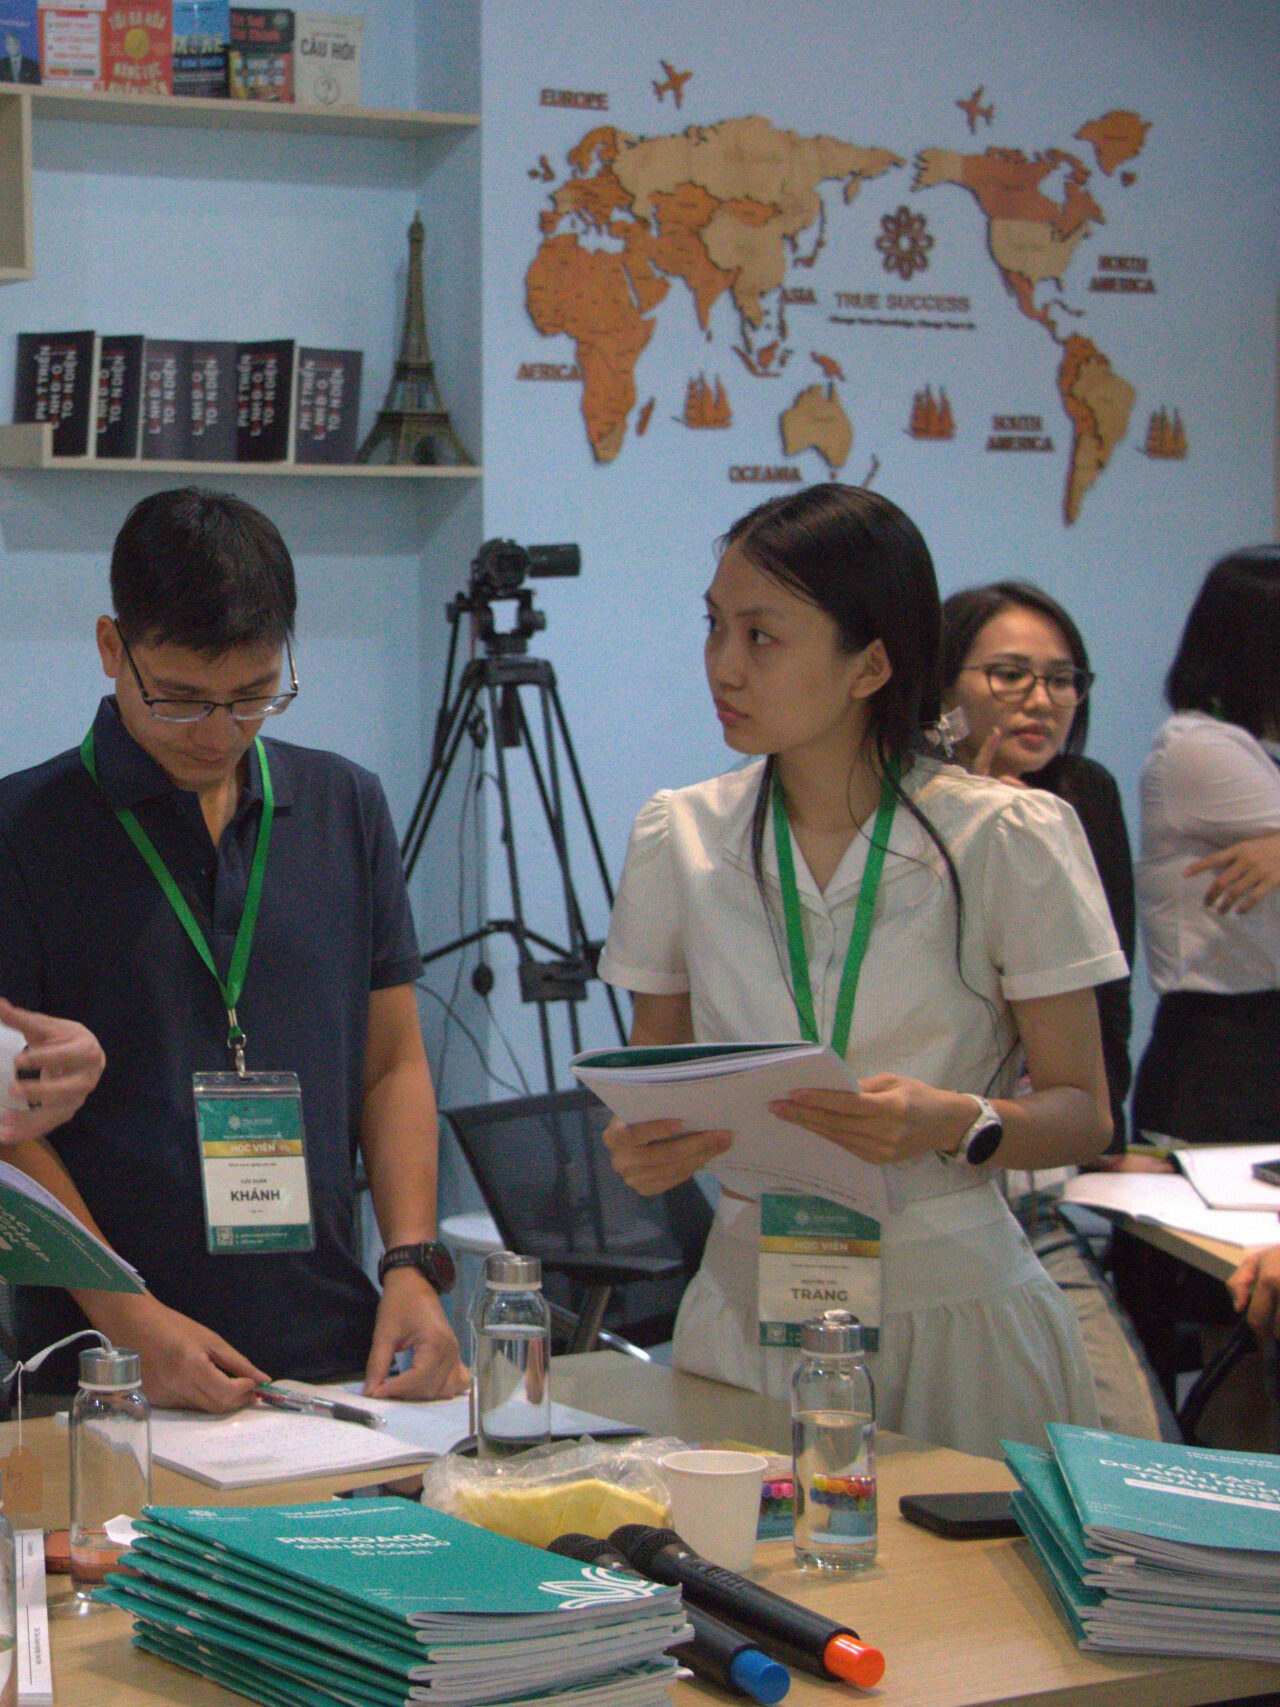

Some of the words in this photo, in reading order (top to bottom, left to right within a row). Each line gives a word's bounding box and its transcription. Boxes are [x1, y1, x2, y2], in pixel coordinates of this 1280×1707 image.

[540, 88, 609, 110] EUROPE
[834, 292, 880, 311] TRUE
[885, 294, 970, 313] SUCCESS
[517, 363, 583, 381] AFRICA
[728, 465, 802, 483] OCEANIA
[230, 1187, 280, 1202] KHÁNH
[791, 1287, 848, 1302] TRANG
